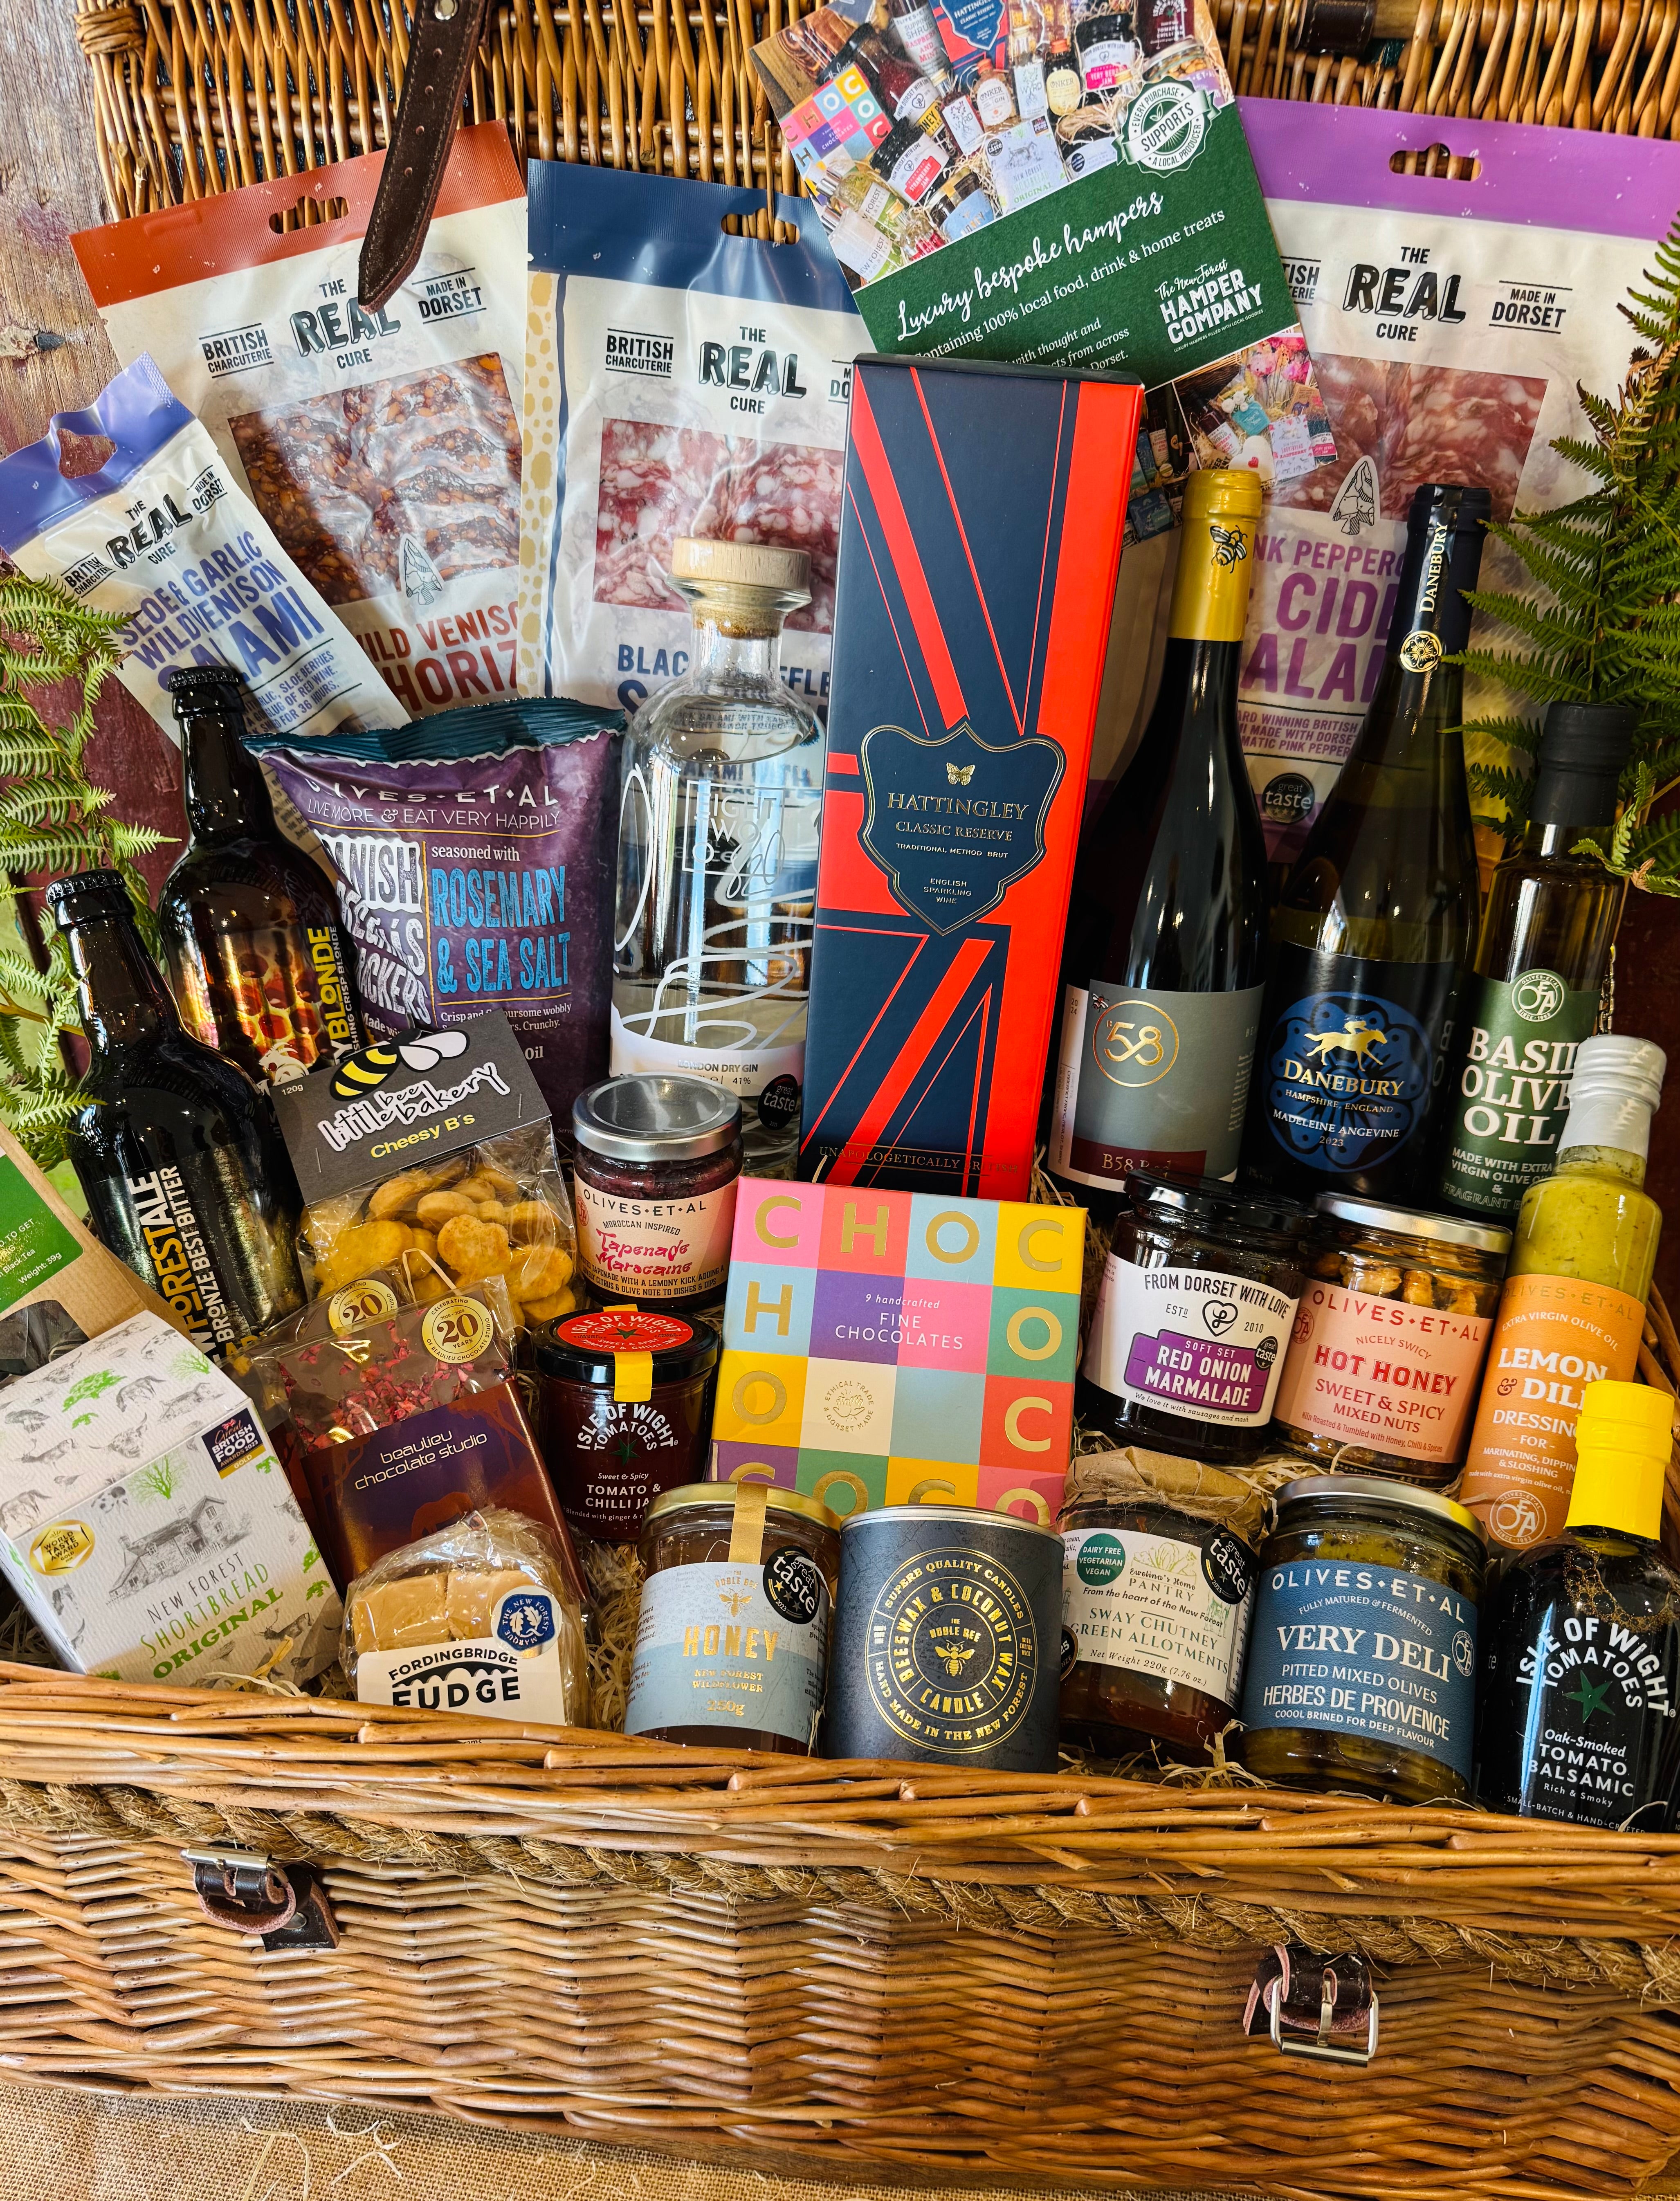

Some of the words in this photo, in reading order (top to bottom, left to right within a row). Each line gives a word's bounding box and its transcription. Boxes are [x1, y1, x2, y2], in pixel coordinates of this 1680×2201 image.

[1135, 106, 1148, 126] EVERY
[1145, 87, 1179, 106] PURCHASE
[1141, 102, 1194, 152] SUPPORTS
[1159, 155, 1178, 166] LOCAL
[1178, 124, 1202, 160] PRODUCER
[908, 163, 933, 191] STRAWBERRY
[921, 179, 930, 189] JAM
[897, 289, 974, 341] Luxury
[974, 236, 1062, 299] bespoke
[1063, 192, 1163, 255] hampers
[982, 307, 1019, 334] 100%
[1021, 294, 1052, 317] local
[1053, 275, 1089, 302] food,
[1090, 258, 1126, 283] drink
[1128, 250, 1141, 264] &
[1141, 231, 1182, 258] home
[1183, 208, 1226, 237] treats
[319, 279, 347, 298] THE
[1159, 269, 1246, 324] HAMPER
[1343, 264, 1466, 324] REAL
[1510, 289, 1541, 302] MADE
[1543, 293, 1556, 304] IN
[1168, 283, 1262, 344] COMPANY
[1492, 302, 1566, 328] DORSET
[202, 329, 268, 361] BRITISH
[1174, 343, 1189, 353] LUXURY
[1189, 335, 1208, 345] HAMPERS
[1208, 328, 1221, 337] FILLED
[1231, 318, 1244, 326] LOCAL
[1245, 309, 1264, 321] GOODIES
[208, 348, 272, 373] CHARCUTERIE
[337, 349, 373, 369] CURE
[607, 335, 673, 360] BRITISH
[606, 355, 672, 373] CHARCUTERIE
[699, 342, 806, 399] REAL
[148, 542, 176, 564] CURE
[168, 581, 189, 606] &
[182, 531, 262, 597] GARLIC
[1419, 521, 1447, 613] DANEBURY
[1261, 714, 1311, 729] WINNING
[1312, 719, 1358, 733] BRITISH
[1279, 740, 1305, 753] PINK
[887, 793, 1029, 820] HATTINGLEY
[1264, 790, 1312, 810] taste
[896, 821, 951, 835] CLASSIC
[955, 826, 1013, 841] RESERVE
[432, 845, 491, 859] seasoned
[493, 847, 520, 861] with
[896, 843, 947, 853] TRADITIONAL
[432, 866, 565, 928] ROSEMARY
[923, 886, 971, 896] SPARKLING
[930, 878, 967, 887] ENGLISH
[330, 926, 343, 973] BLONDE
[438, 937, 458, 994] &
[466, 939, 512, 992] SEA
[519, 932, 570, 989] SALT
[308, 927, 350, 1040] BLONDE
[340, 977, 352, 1012] CRISP
[721, 1063, 740, 1072] DRY
[741, 1063, 758, 1072] GIN
[1283, 1058, 1405, 1096] DANEBURY
[282, 1084, 303, 1096] 120g
[763, 1092, 796, 1112] taste
[1285, 1089, 1341, 1109] HAMPSHIRE,
[1345, 1103, 1393, 1113] ENGLAND
[1273, 1109, 1335, 1132] MADELEINE
[1338, 1126, 1399, 1137] ANGEVINE
[1464, 1106, 1556, 1145] OIL
[370, 1125, 440, 1158] Cheesy
[1319, 1136, 1343, 1147] 2023
[1453, 1147, 1482, 1165] MADE
[1485, 1157, 1517, 1171] WITH
[1521, 1163, 1552, 1172] EXTRA
[127, 1171, 173, 1227] ALE
[160, 1166, 196, 1227] BITTER
[5, 1231, 17, 1244] TO
[19, 1218, 34, 1232] GET
[603, 1220, 642, 1229] MOROCCAN
[645, 1222, 681, 1235] INSPIRED
[181, 1230, 211, 1271] BEST
[596, 1228, 690, 1262] Tapenade
[18, 1262, 48, 1284] Weight:
[46, 1252, 62, 1266] 39g
[865, 1294, 872, 1302] 9
[876, 1294, 941, 1309] handcrafted
[1144, 1274, 1179, 1290] FROM
[1184, 1275, 1237, 1298] DORSET
[1239, 1285, 1269, 1308] WITH
[194, 1272, 235, 1343] BRONZE
[880, 1313, 921, 1329] FINE
[453, 1338, 473, 1349] YEARS
[835, 1325, 963, 1349] CHOCOLATES
[1244, 1322, 1264, 1333] 2010
[1502, 1314, 1527, 1332] EXTRA
[1528, 1312, 1568, 1322] VIRGIN
[1570, 1316, 1602, 1337] OLIVE
[1604, 1333, 1619, 1352] OIL
[1356, 1336, 1395, 1345] NICELY
[1398, 1339, 1432, 1359] SWICY
[1157, 1345, 1193, 1371] RED
[1200, 1357, 1252, 1383] ONION
[1313, 1344, 1366, 1377] HOT
[1370, 1359, 1458, 1396] HONEY
[1498, 1348, 1608, 1381] LEMON
[1145, 1367, 1251, 1407] MARMALADE
[1315, 1379, 1375, 1405] SWEET
[1378, 1396, 1392, 1411] &
[1397, 1400, 1445, 1420] SPICY
[1333, 1403, 1381, 1424] MIXED
[1384, 1417, 1420, 1433] NUTS
[215, 1433, 256, 1462] FOOD
[234, 1454, 253, 1469] GOLD
[355, 1452, 436, 1490] chocolate
[439, 1433, 487, 1459] studio
[380, 1431, 452, 1464] beaulieu
[630, 1472, 649, 1481] Spicy
[1507, 1461, 1559, 1479] SLOSHING
[585, 1498, 632, 1508] CHILLI
[587, 1485, 647, 1495] TOMATO
[652, 1484, 661, 1492] &
[1079, 1557, 1123, 1566] VEGETARIAN
[147, 1591, 185, 1624] NEW
[188, 1552, 243, 1597] FOREST
[773, 1556, 817, 1615] taste
[885, 1568, 923, 1608] SUPERB
[926, 1559, 982, 1573] QUALITY
[984, 1569, 1024, 1619] CANDLES
[140, 1563, 269, 1658] SHORTBREAD
[775, 1599, 787, 1612] 2023
[1299, 1599, 1323, 1615] FULLY
[1325, 1595, 1370, 1605] MATURED
[1381, 1602, 1432, 1635] FERMENTED
[153, 1587, 283, 1679] ORIGINAL
[683, 1624, 779, 1661] HONEY
[1089, 1608, 1136, 1624] SWAY
[1141, 1617, 1217, 1649] CHUTNEY
[389, 1648, 517, 1681] FORDINGBRIDGE
[1277, 1625, 1366, 1655] VERY
[1372, 1632, 1451, 1682] DELI
[393, 1676, 520, 1709] FUDGE
[1282, 1664, 1328, 1677] PITTED
[1333, 1666, 1384, 1686] MIXED
[1388, 1677, 1437, 1704] OLIVES
[707, 1700, 745, 1716] 250g
[920, 1688, 984, 1714] CANDLE
[1544, 1729, 1626, 1758] Oak-Smoked
[1528, 1760, 1634, 1797] BALSAMIC
[1544, 1782, 1565, 1794] Rich
[1580, 1792, 1613, 1807] Smoky
